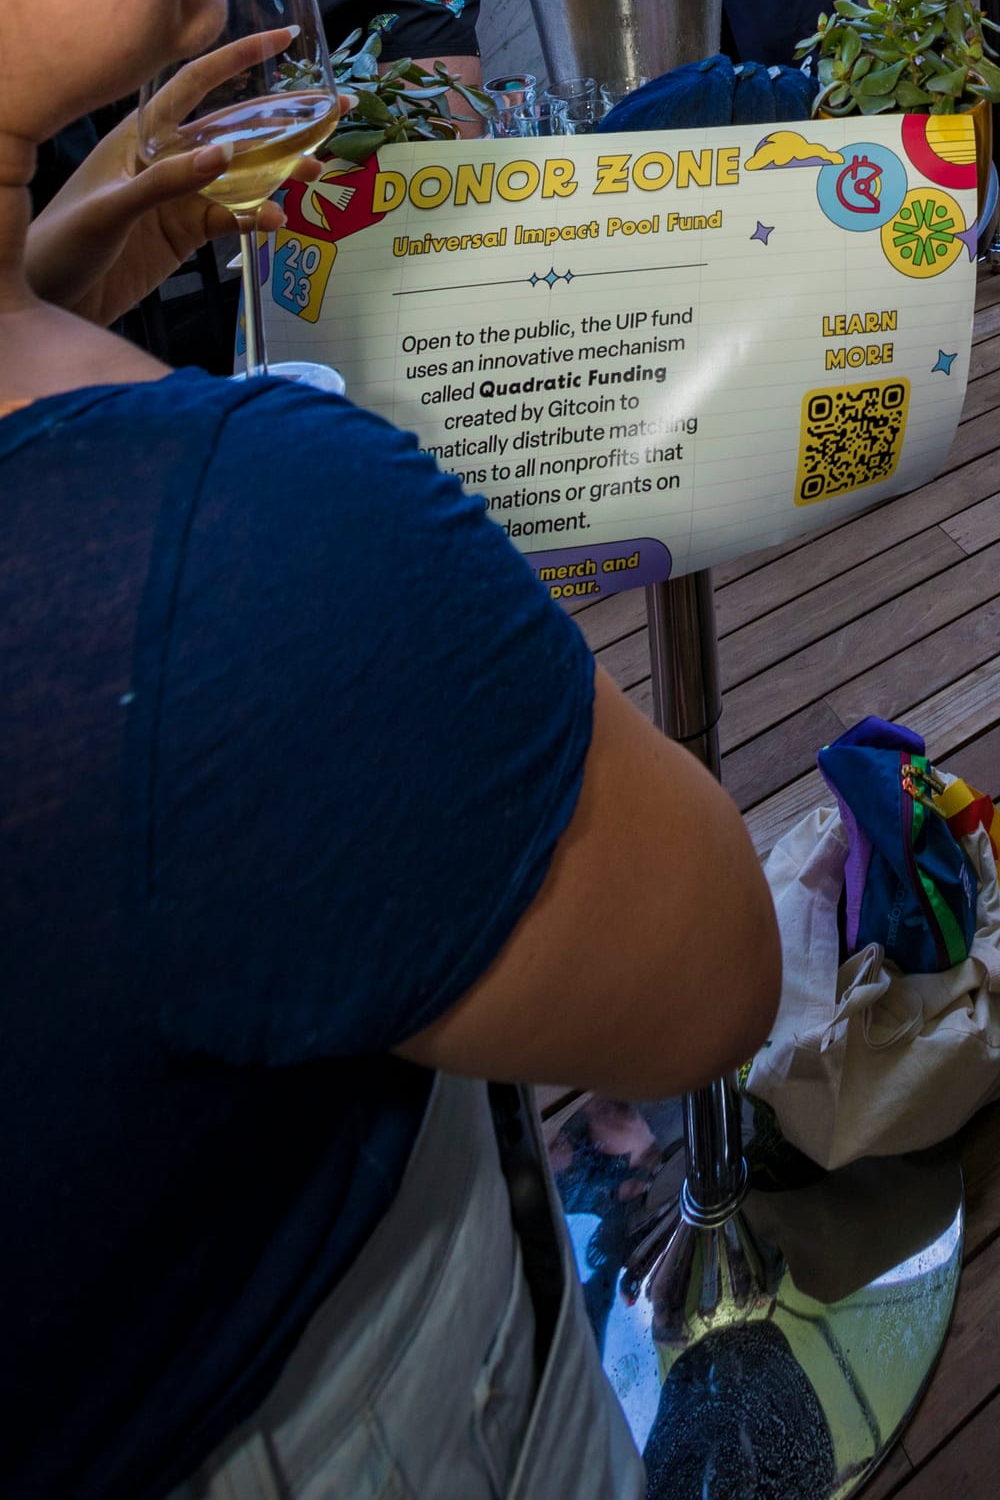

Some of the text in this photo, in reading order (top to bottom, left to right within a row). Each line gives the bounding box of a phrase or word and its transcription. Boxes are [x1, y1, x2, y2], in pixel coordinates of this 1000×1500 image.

[372, 147, 740, 214] DONOR ZONE
[392, 210, 722, 257] Universal Impact Pool Fund
[285, 238, 321, 276] 20
[282, 271, 311, 308] 23
[402, 307, 693, 354] Open to the public, the UIP fund
[823, 310, 897, 337] LEARN
[406, 336, 685, 379] uses an innovative mechanism
[825, 343, 893, 370] MORE
[421, 365, 667, 405] called Quadratic Funding
[444, 394, 639, 430] created by Gitcoin to
[513, 425, 604, 450] distribute
[491, 464, 510, 481] to
[515, 458, 535, 478] all
[540, 448, 639, 475] nonprofits
[645, 444, 683, 463] that
[565, 485, 586, 501] or
[590, 476, 652, 502] grants
[656, 475, 680, 490] on
[540, 551, 640, 581] merch and
